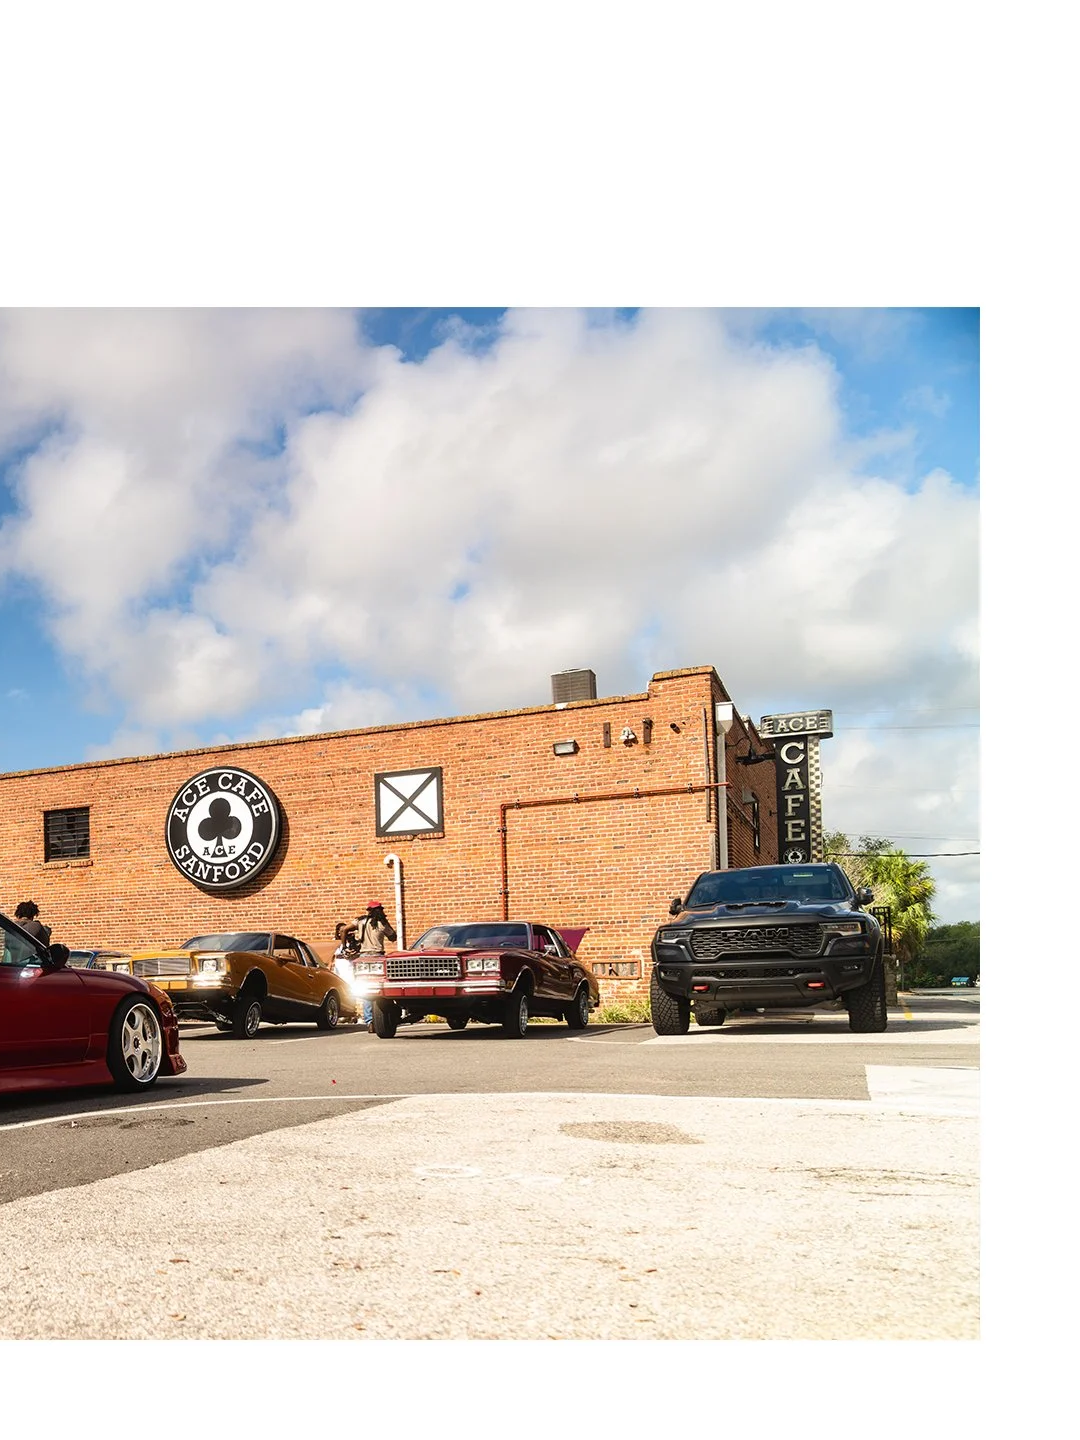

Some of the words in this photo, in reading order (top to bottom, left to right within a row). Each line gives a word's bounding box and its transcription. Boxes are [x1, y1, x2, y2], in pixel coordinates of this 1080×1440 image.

[776, 716, 817, 733] ACE
[173, 778, 210, 822] ACE
[218, 773, 269, 818] CAFE
[780, 742, 806, 842] CAFE
[174, 841, 265, 882] SANFORD
[202, 845, 236, 857] ACE
[721, 928, 789, 939] RAM
